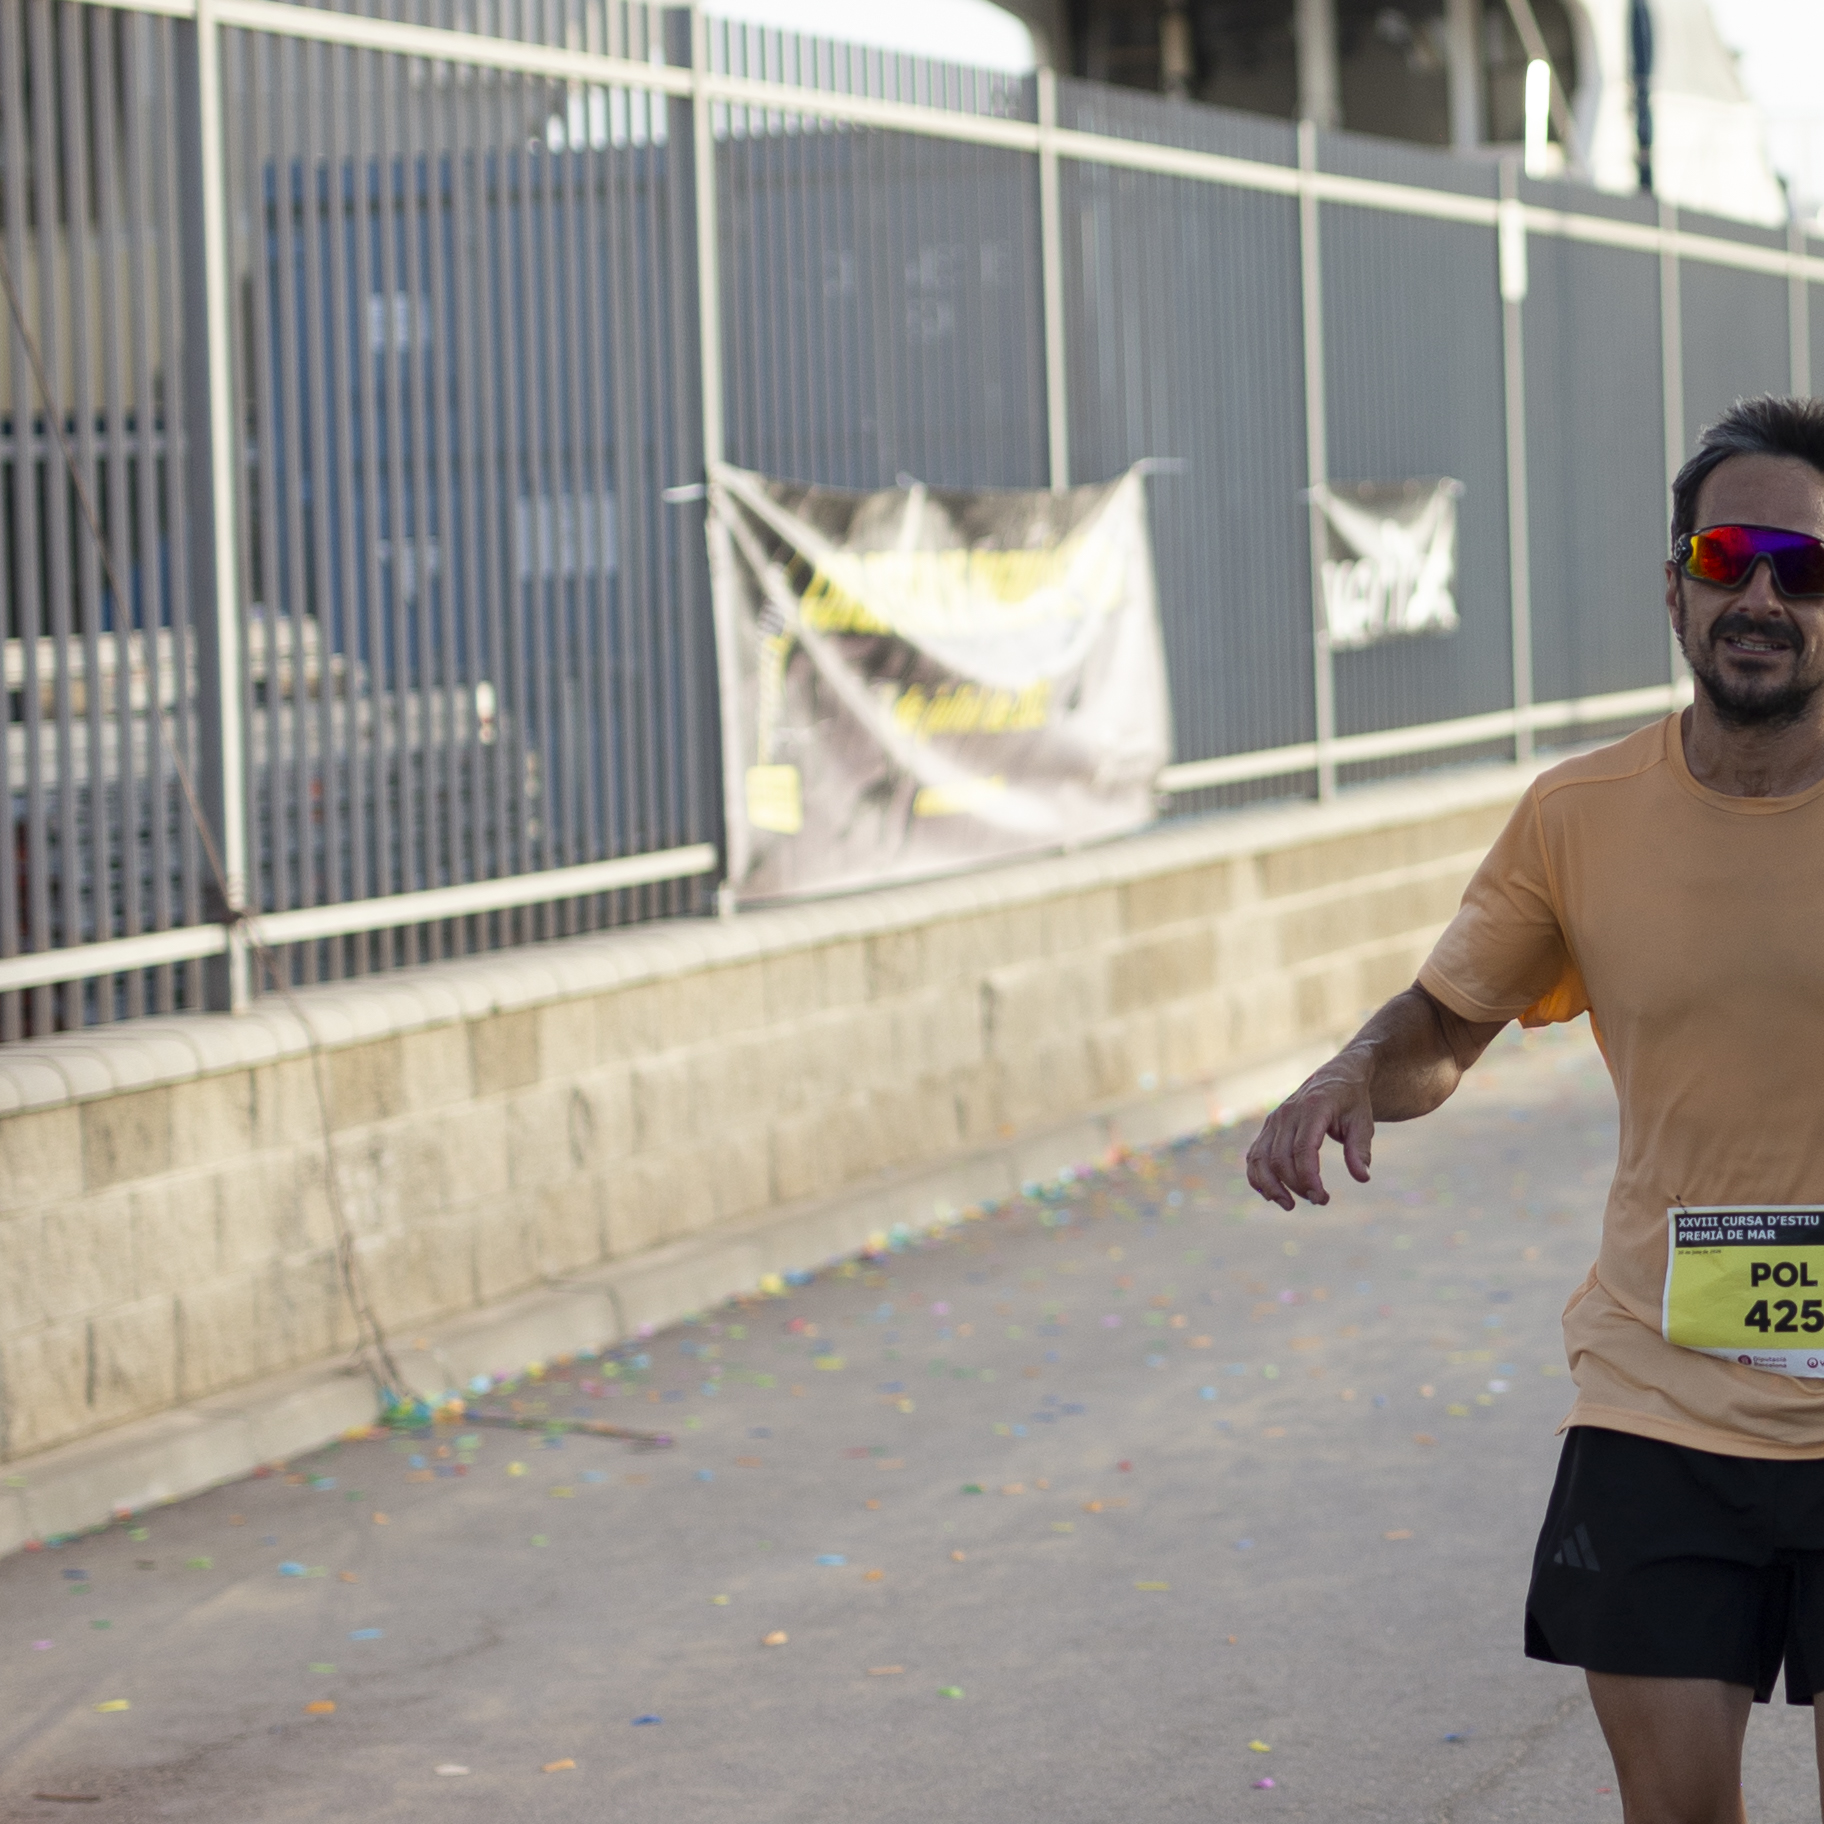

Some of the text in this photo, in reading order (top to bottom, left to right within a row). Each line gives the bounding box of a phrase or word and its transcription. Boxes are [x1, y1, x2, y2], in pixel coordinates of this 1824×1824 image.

[1678, 1216, 1719, 1228] XXVIII
[1721, 1215, 1764, 1226] CURSA
[1767, 1215, 1820, 1226] D'ESTIU
[1678, 1227, 1776, 1242] PREMIÀ DE MAR
[1751, 1261, 1818, 1287] POL
